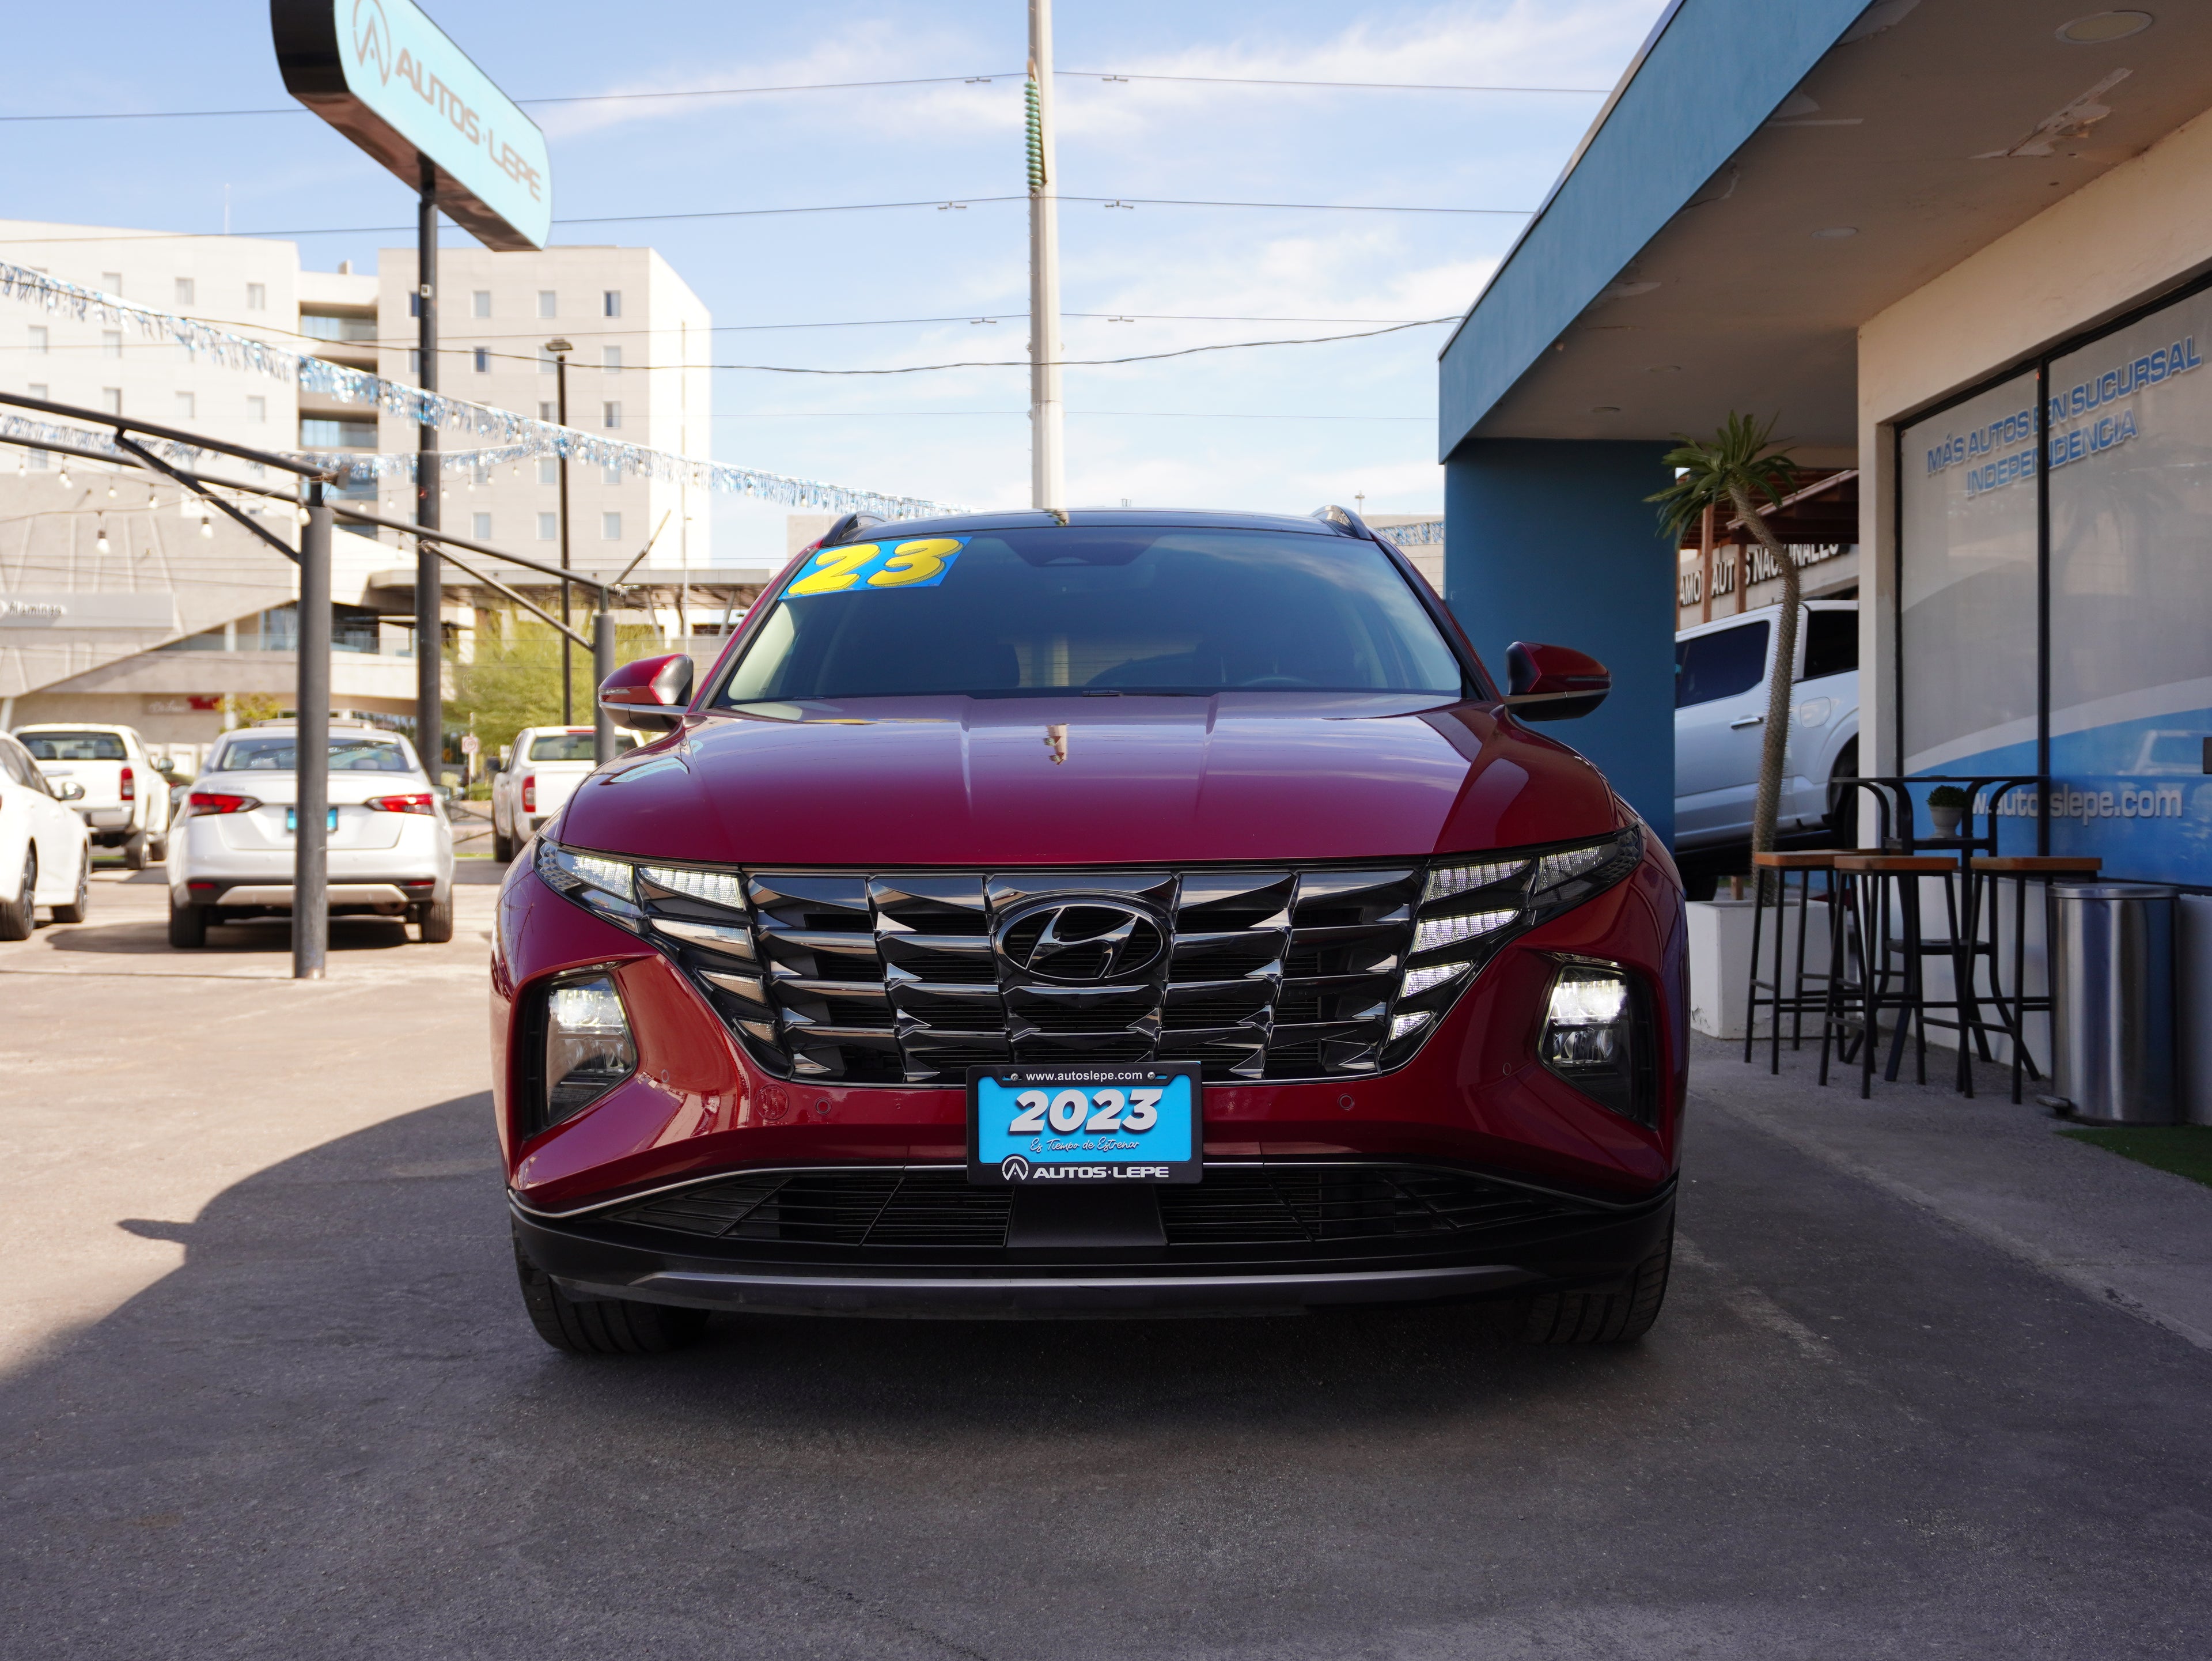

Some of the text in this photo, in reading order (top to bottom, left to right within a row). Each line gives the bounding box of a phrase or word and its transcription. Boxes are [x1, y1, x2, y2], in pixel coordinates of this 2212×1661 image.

[1927, 335, 2202, 475] MÁS AUTOS EN SUCURSAL
[1967, 408, 2138, 497] INDEPENDENCIA
[787, 538, 964, 595] 23
[1026, 1070, 1142, 1082] www.autoslepe.com
[1009, 1088, 1163, 1132] 2023
[1030, 1137, 1139, 1152] Es Tiempo de Estrenar
